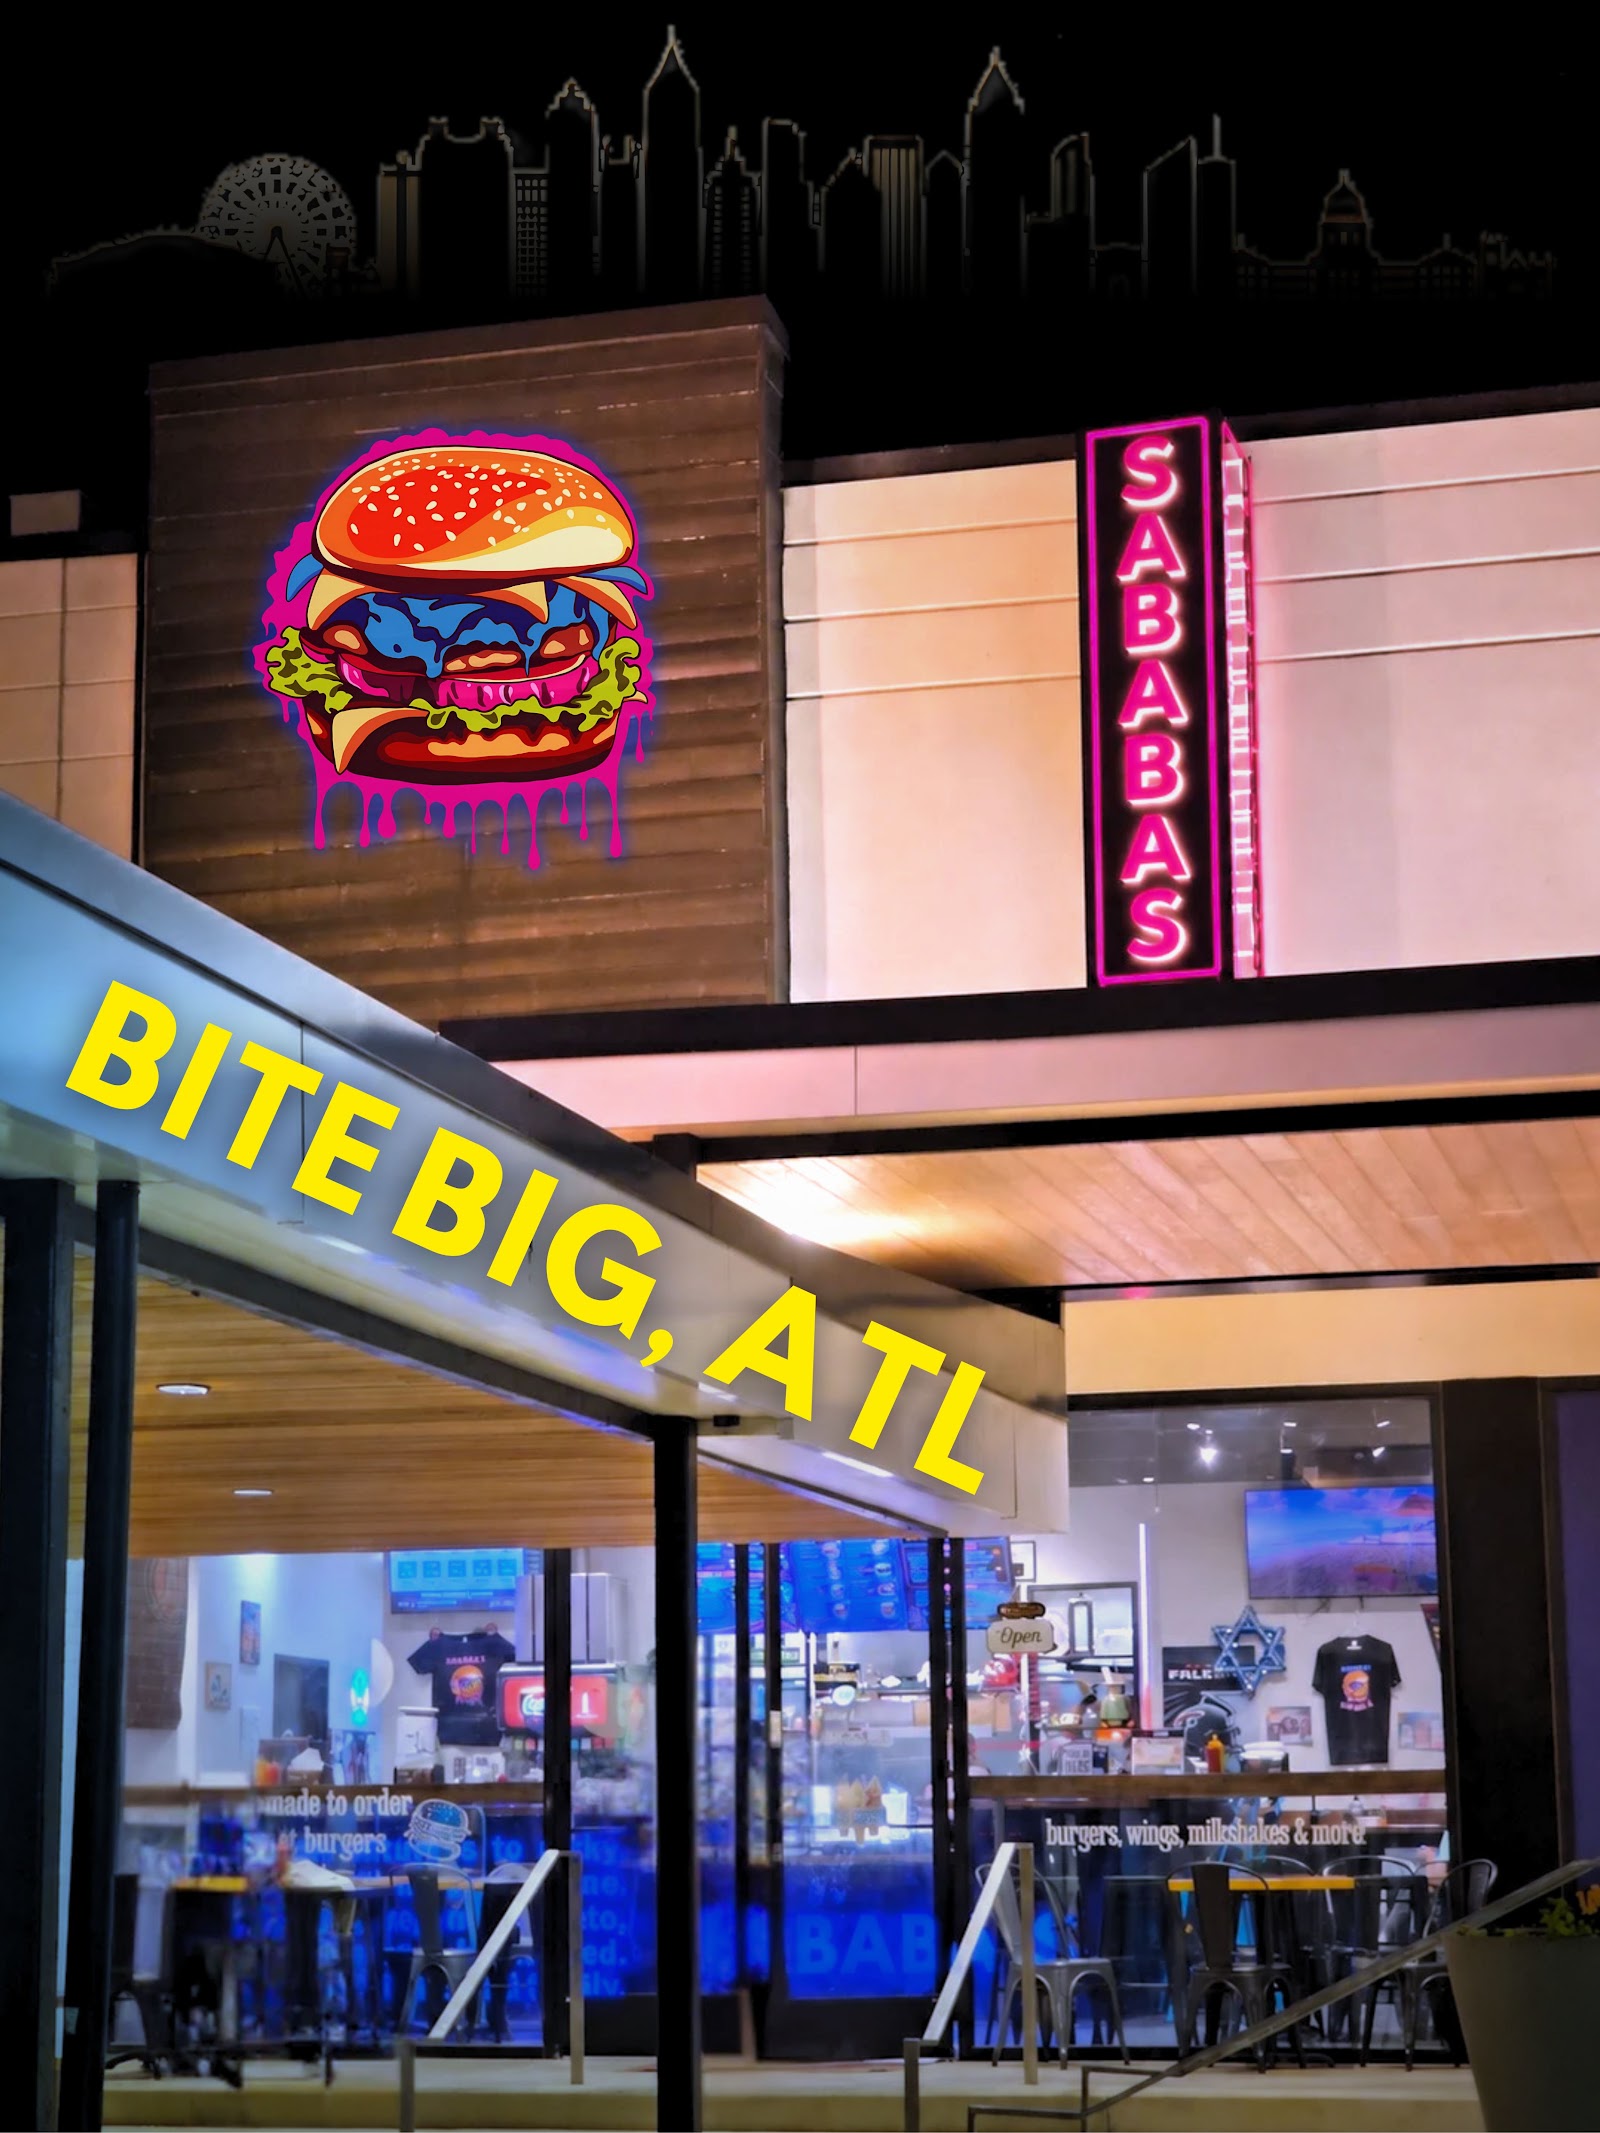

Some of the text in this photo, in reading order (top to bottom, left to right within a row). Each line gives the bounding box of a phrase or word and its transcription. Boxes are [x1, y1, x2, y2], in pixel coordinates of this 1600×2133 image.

[1116, 434, 1192, 965] SABABAS
[1001, 1626, 1042, 1649] Open
[326, 1789, 348, 1817] to
[354, 1787, 413, 1817] order
[304, 1826, 387, 1861] burgers
[1045, 1818, 1122, 1852] burgers,
[1126, 1819, 1184, 1852] wings,
[1187, 1818, 1289, 1845] milkshakes
[1293, 1818, 1309, 1845] &
